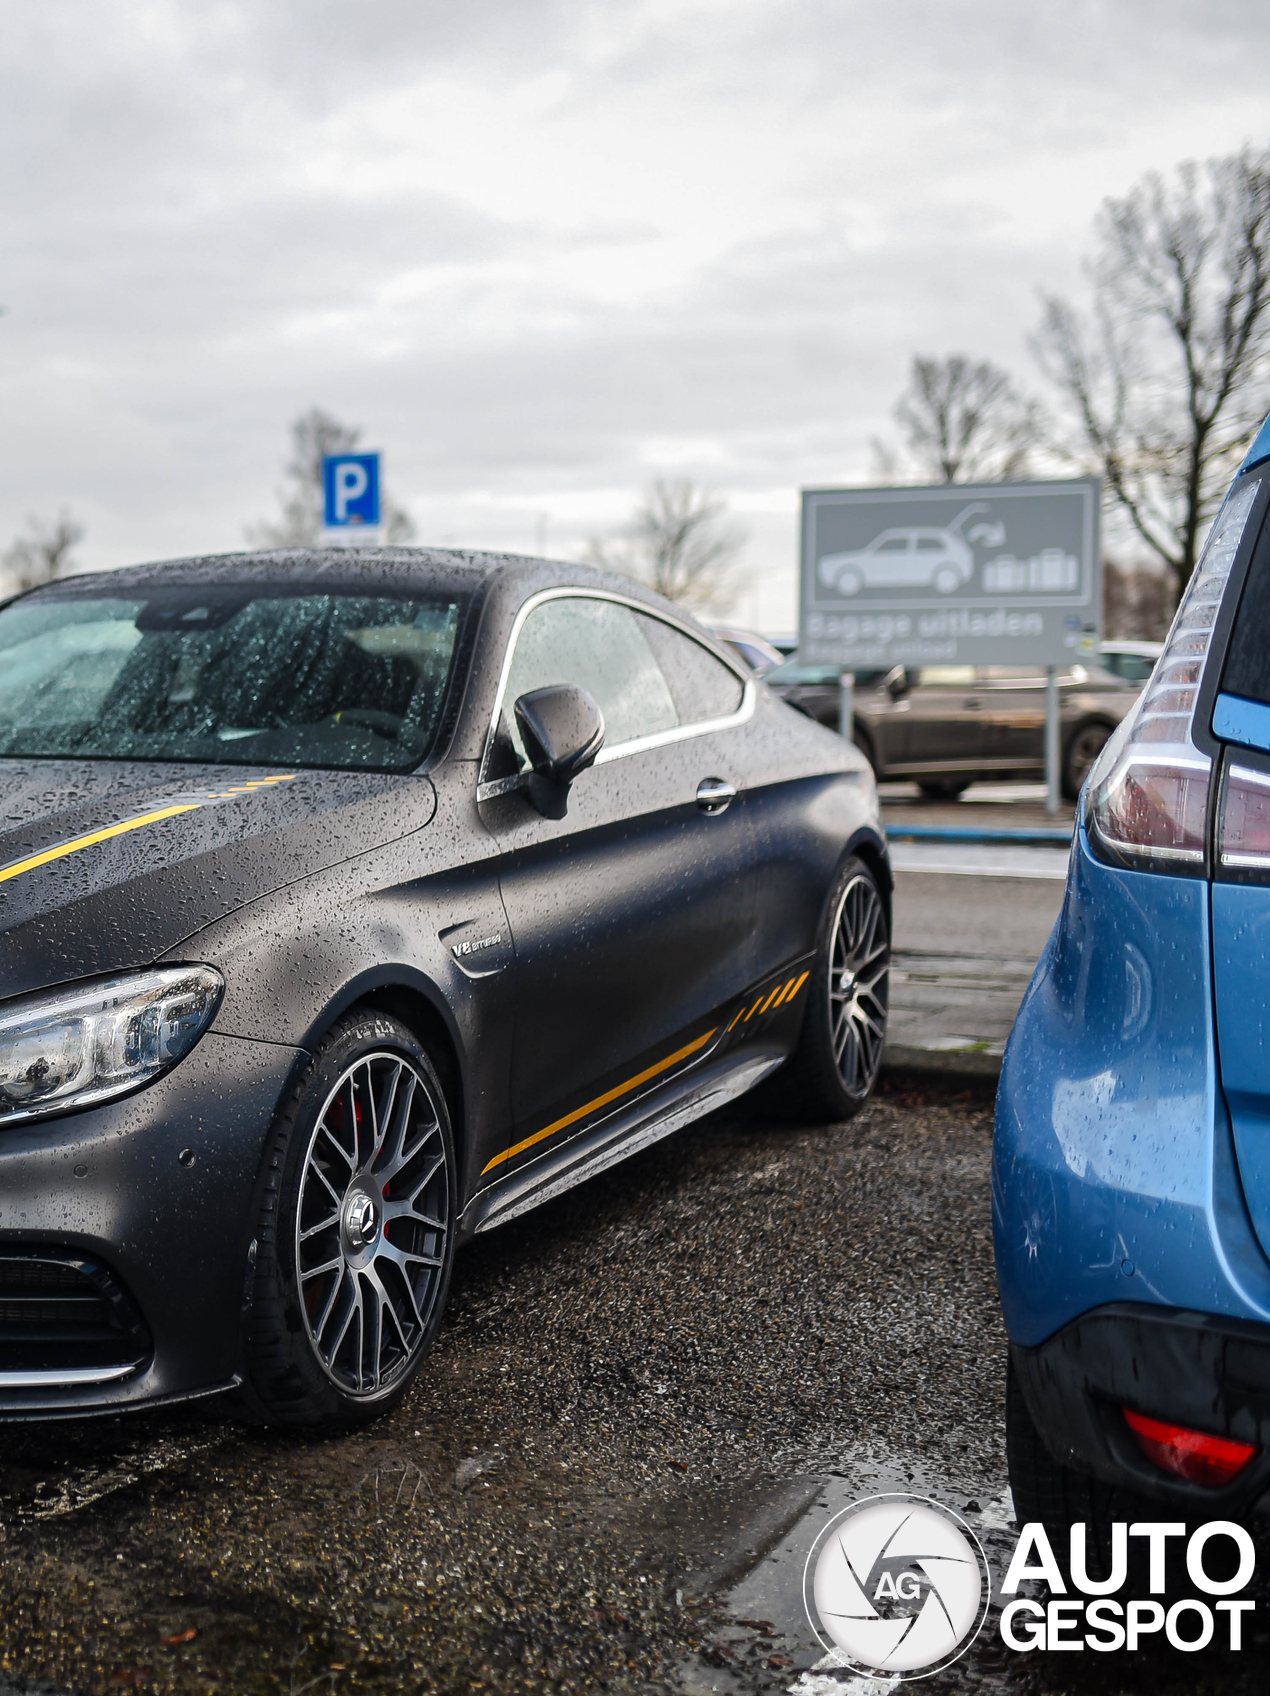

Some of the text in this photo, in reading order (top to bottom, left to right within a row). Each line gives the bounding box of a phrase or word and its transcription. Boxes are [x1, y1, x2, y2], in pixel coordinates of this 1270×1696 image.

[334, 462, 368, 520] P
[807, 608, 1043, 644] Bagage uitladen
[452, 941, 471, 957] V8
